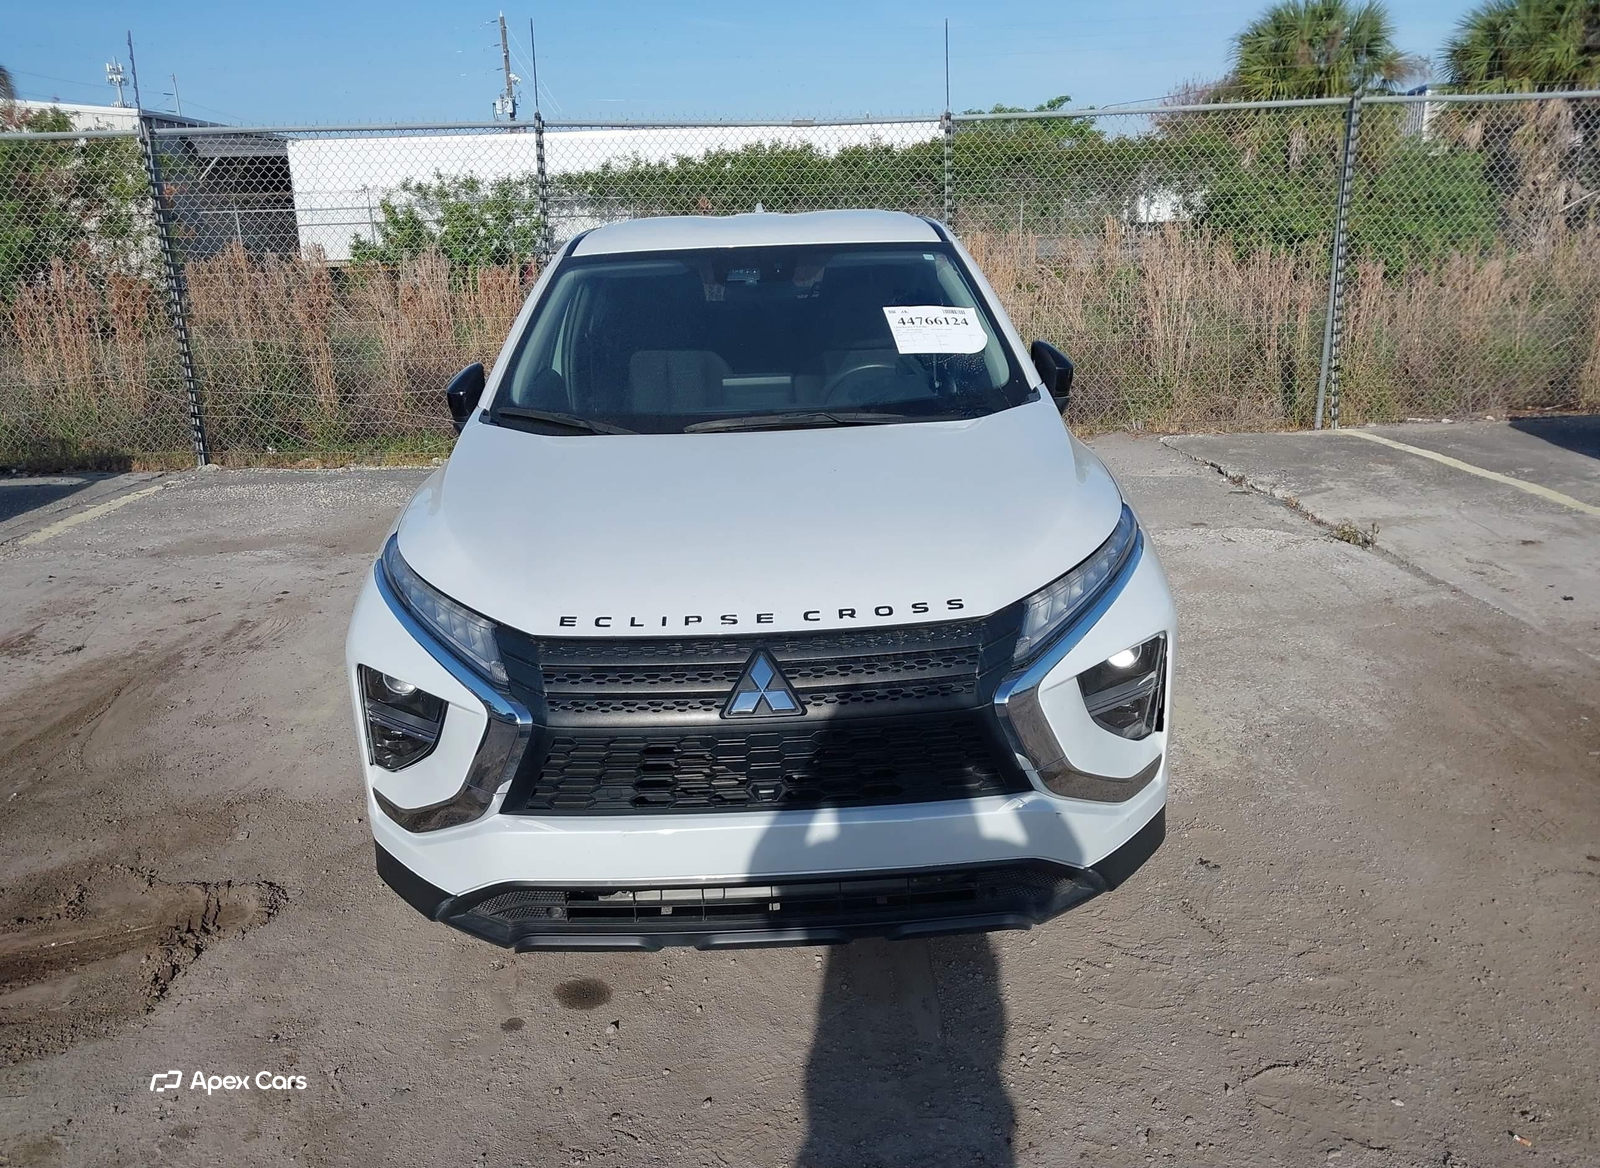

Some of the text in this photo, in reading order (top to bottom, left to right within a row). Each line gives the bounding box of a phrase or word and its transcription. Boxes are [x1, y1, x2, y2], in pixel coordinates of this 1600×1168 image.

[897, 316, 969, 326] 44766124
[559, 598, 965, 628] ECLIPSE CROSS
